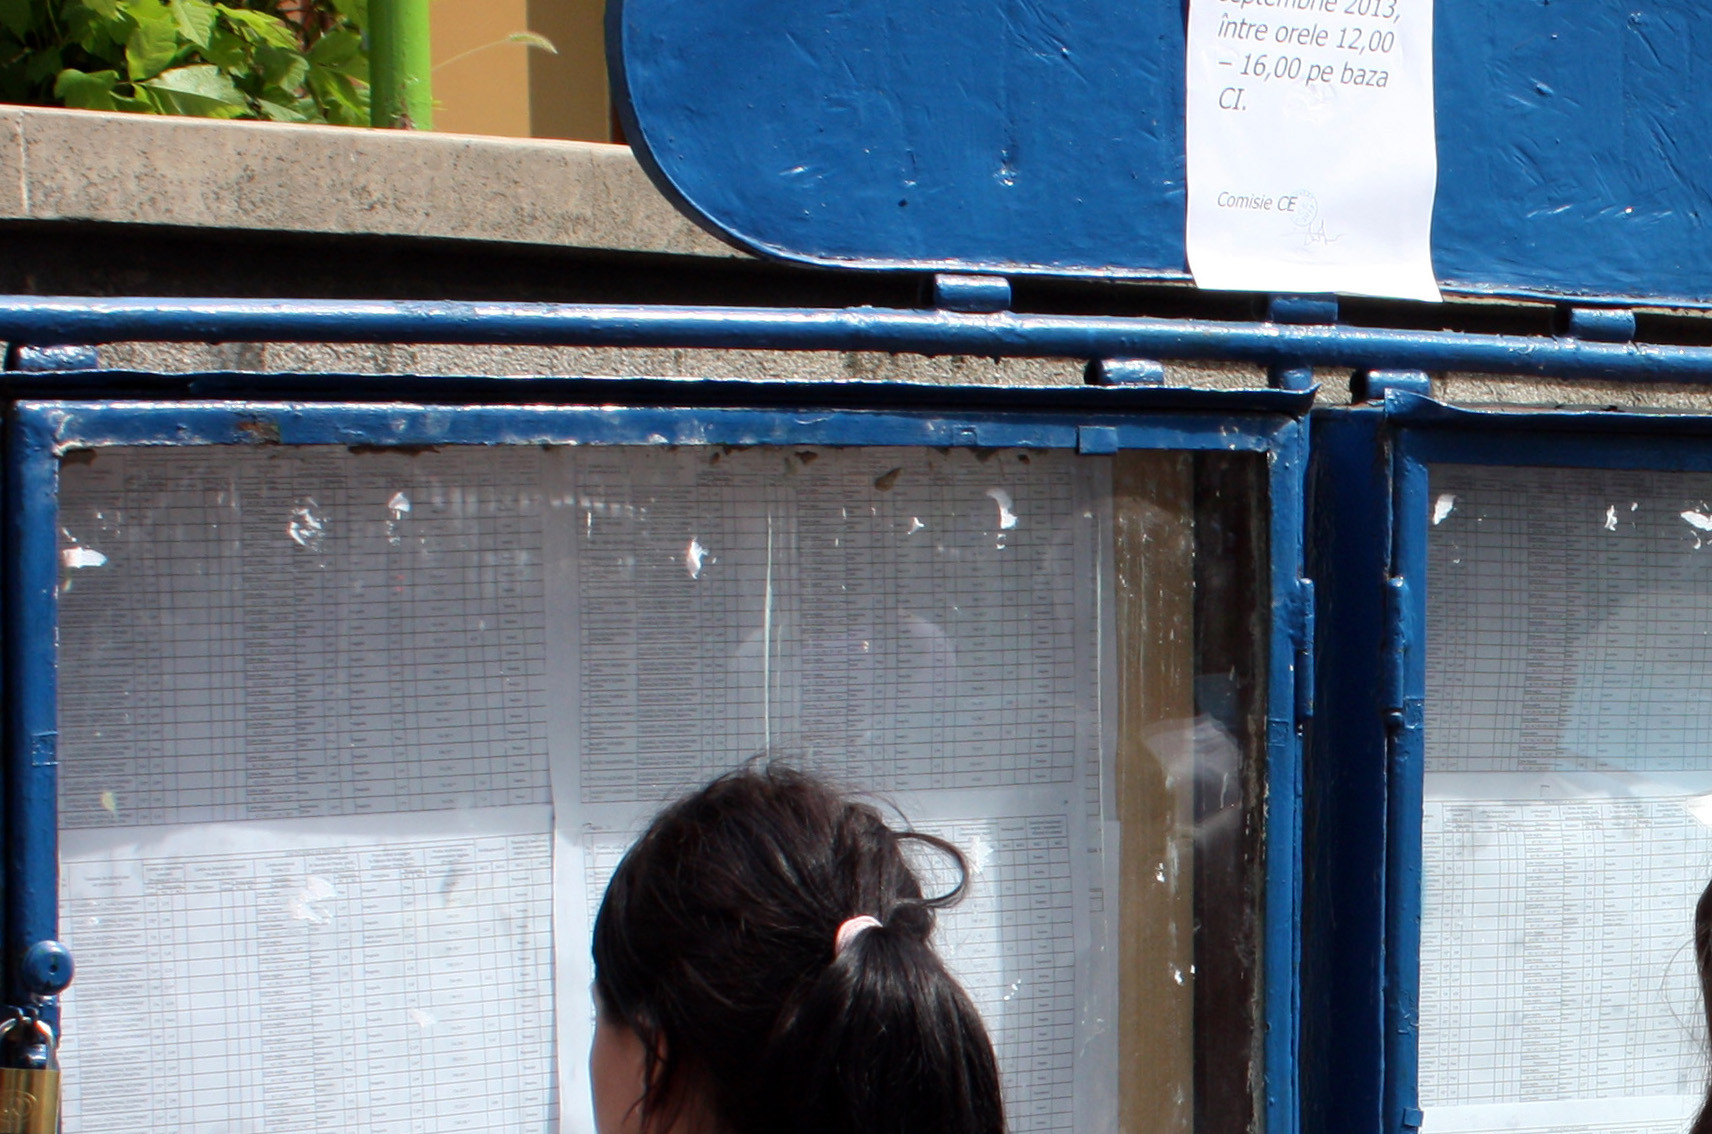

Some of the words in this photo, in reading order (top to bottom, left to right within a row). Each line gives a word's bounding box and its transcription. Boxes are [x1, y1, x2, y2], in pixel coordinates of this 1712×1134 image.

[1344, 0, 1401, 23] 2013,
[1217, 12, 1268, 41] între
[1275, 24, 1329, 47] orele
[1336, 27, 1395, 55] 12,00
[1240, 53, 1301, 81] 16,00
[1305, 63, 1334, 86] pe
[1340, 61, 1389, 87] baza
[1218, 87, 1246, 111] CI.
[1217, 191, 1273, 210] Comisie
[1277, 195, 1298, 212] CE
